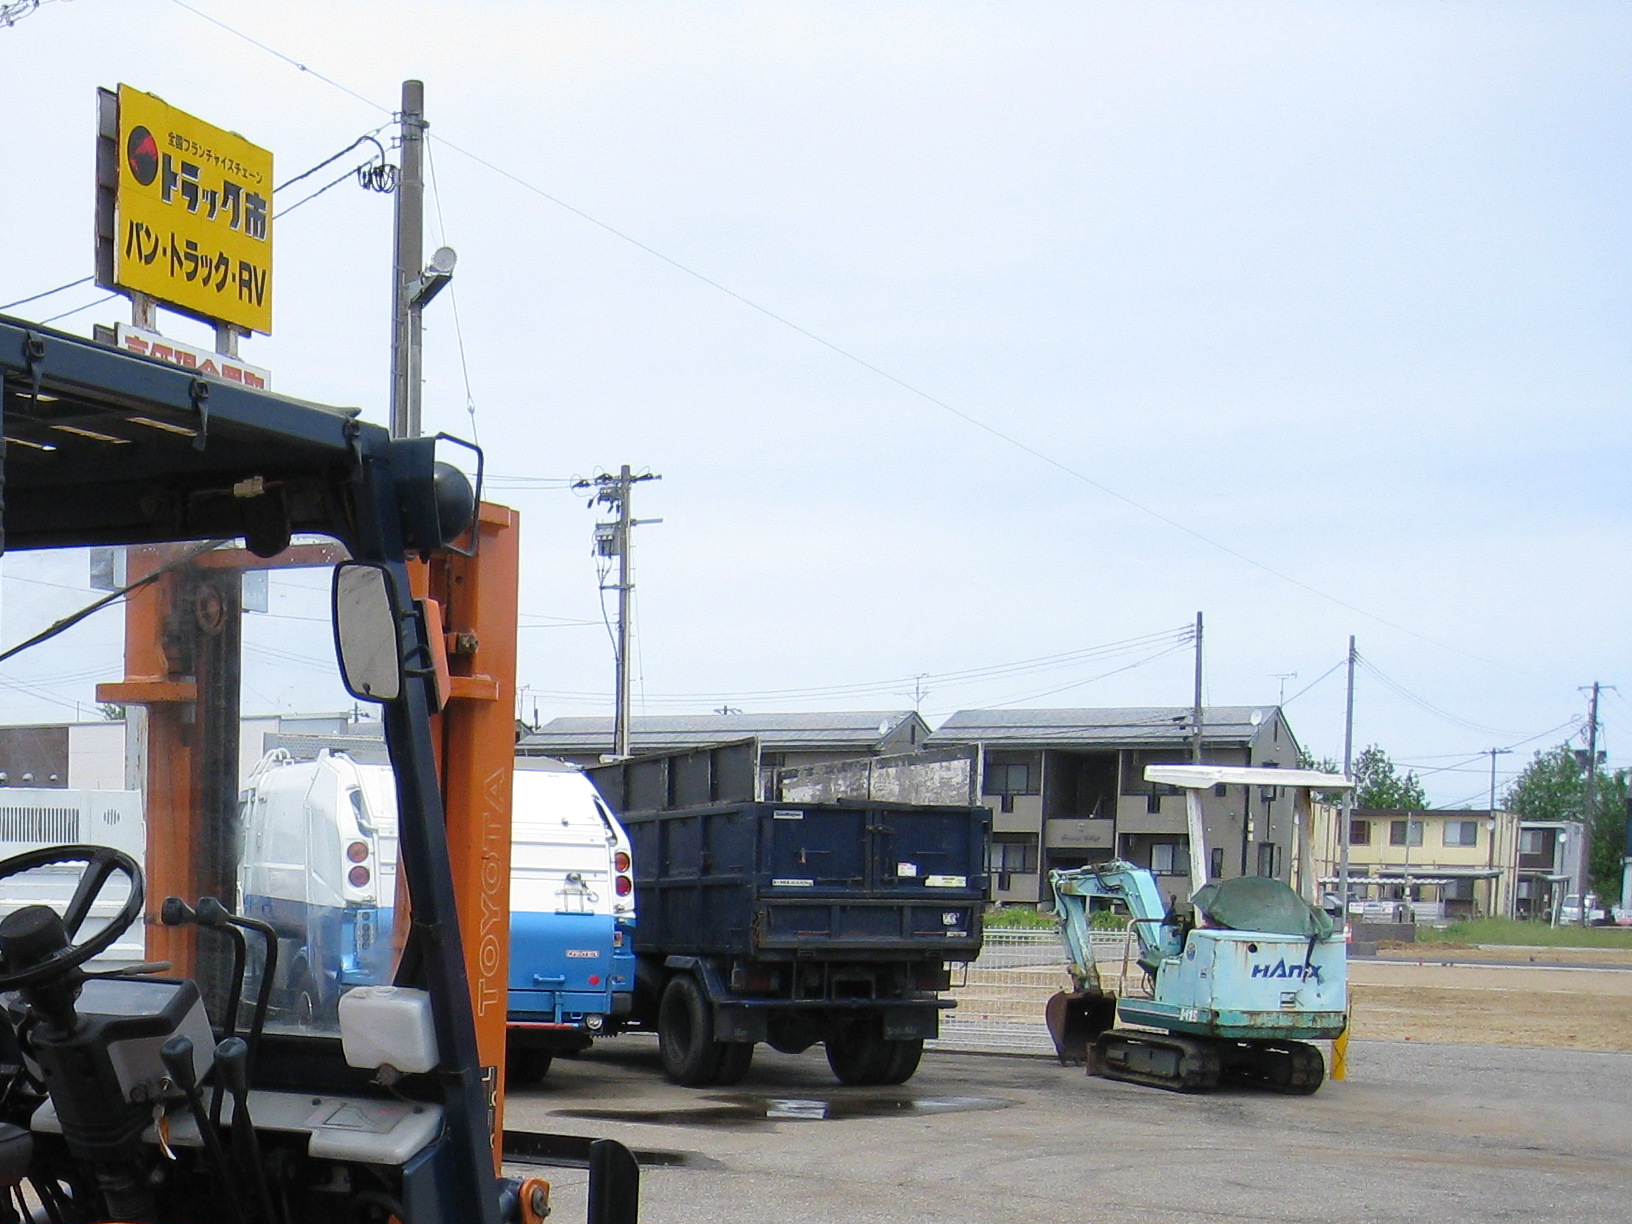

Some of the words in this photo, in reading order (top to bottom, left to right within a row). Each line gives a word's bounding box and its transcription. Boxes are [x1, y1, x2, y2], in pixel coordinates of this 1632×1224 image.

[161, 152, 267, 242] トラック市
[478, 766, 505, 1018] TOYOTA
